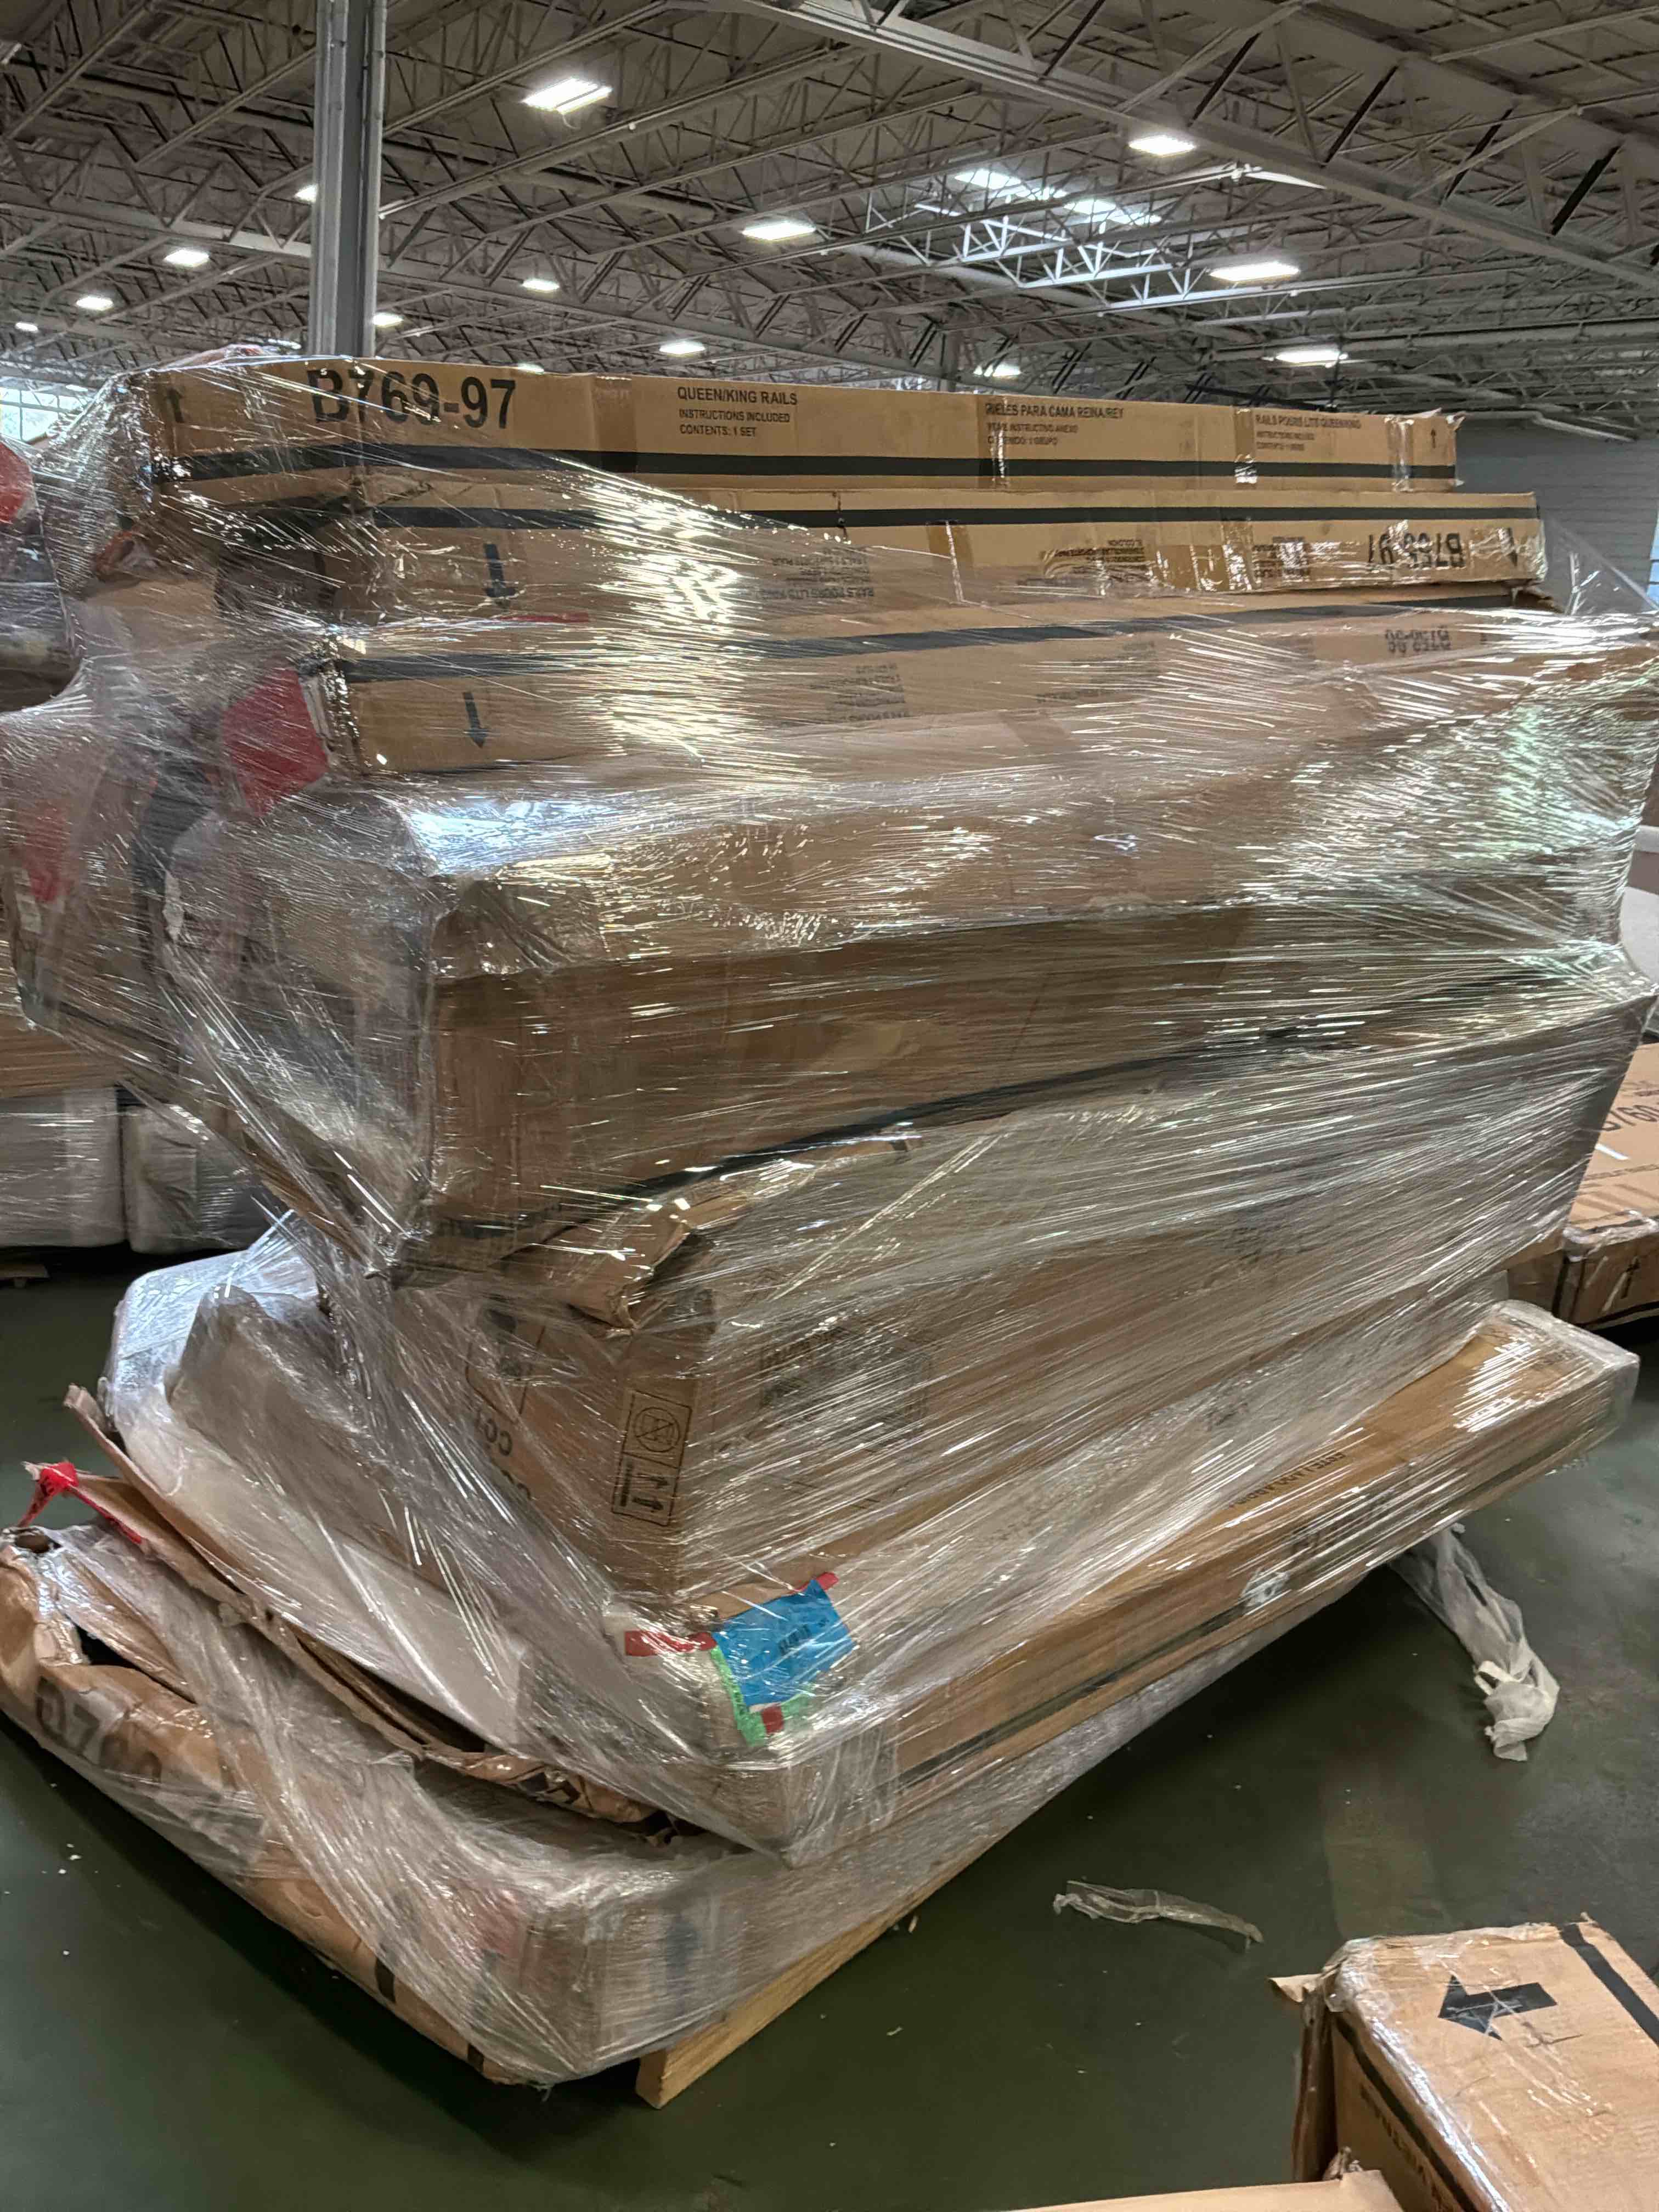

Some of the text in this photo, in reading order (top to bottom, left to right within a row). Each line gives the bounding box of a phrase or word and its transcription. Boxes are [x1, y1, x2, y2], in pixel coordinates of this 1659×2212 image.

[307, 368, 516, 429] B769-97
[677, 386, 798, 405] QUEEN/KING RAILS
[679, 409, 791, 423] INSTRUCTIONS INCLUDED
[1021, 404, 1046, 417] PARA
[1048, 405, 1076, 418] CAMA
[679, 424, 731, 436] CONTENTS:
[740, 426, 757, 437] SET
